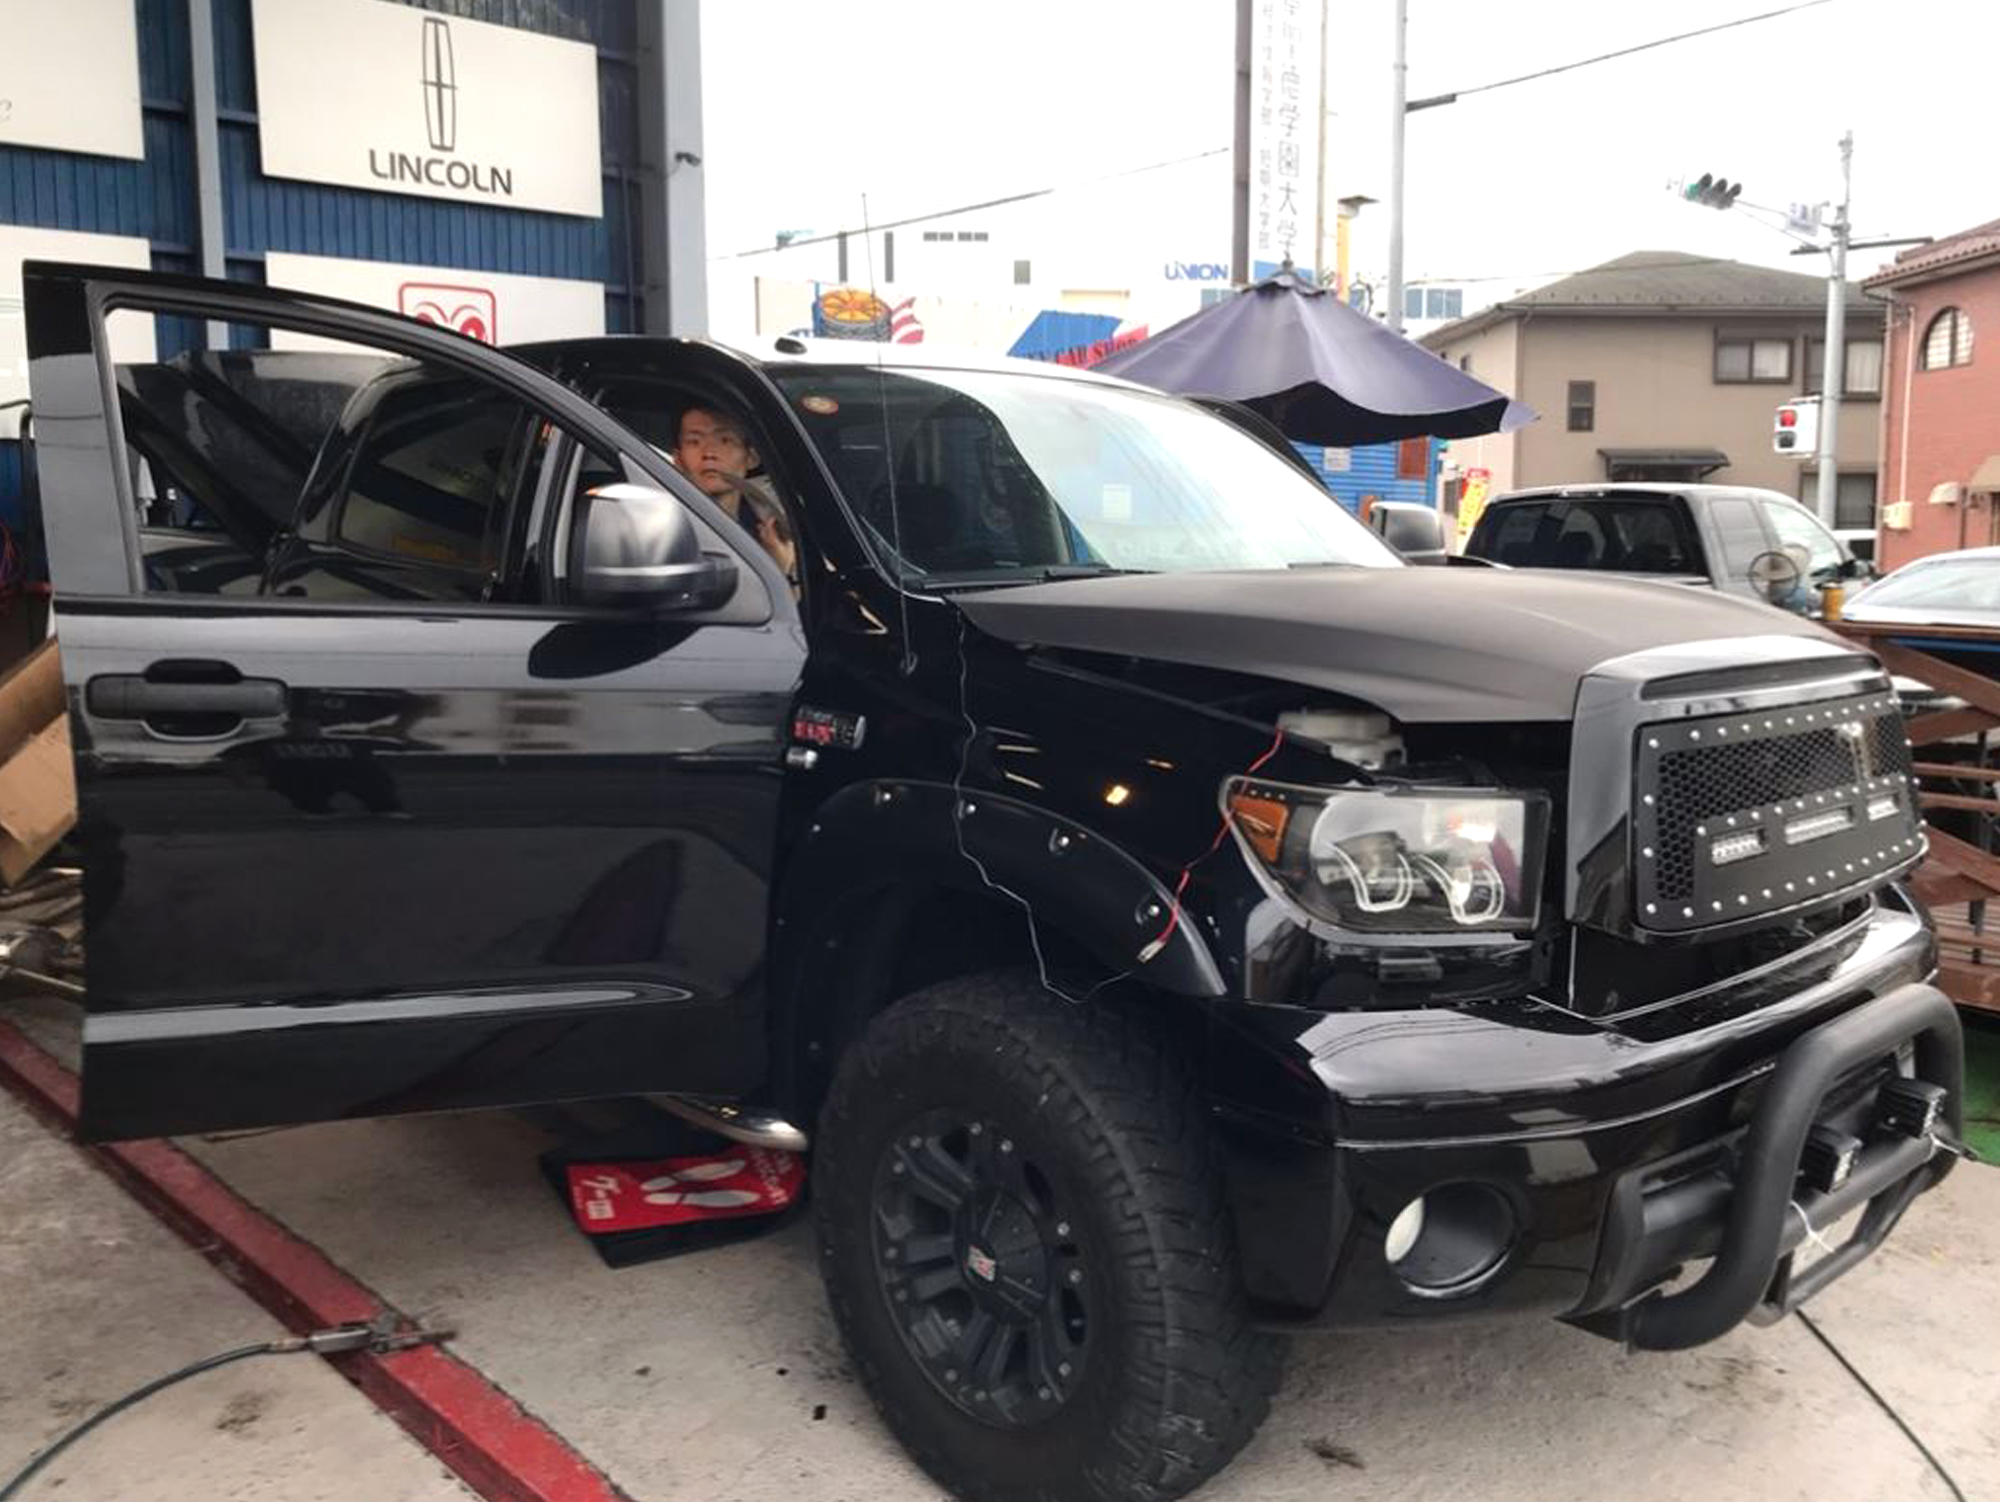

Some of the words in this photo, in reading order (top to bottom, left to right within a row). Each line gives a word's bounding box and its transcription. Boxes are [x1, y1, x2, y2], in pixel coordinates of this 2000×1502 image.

[369, 149, 512, 195] LINCOLN
[1164, 263, 1229, 280] UNION
[1055, 346, 1088, 367] CAR
